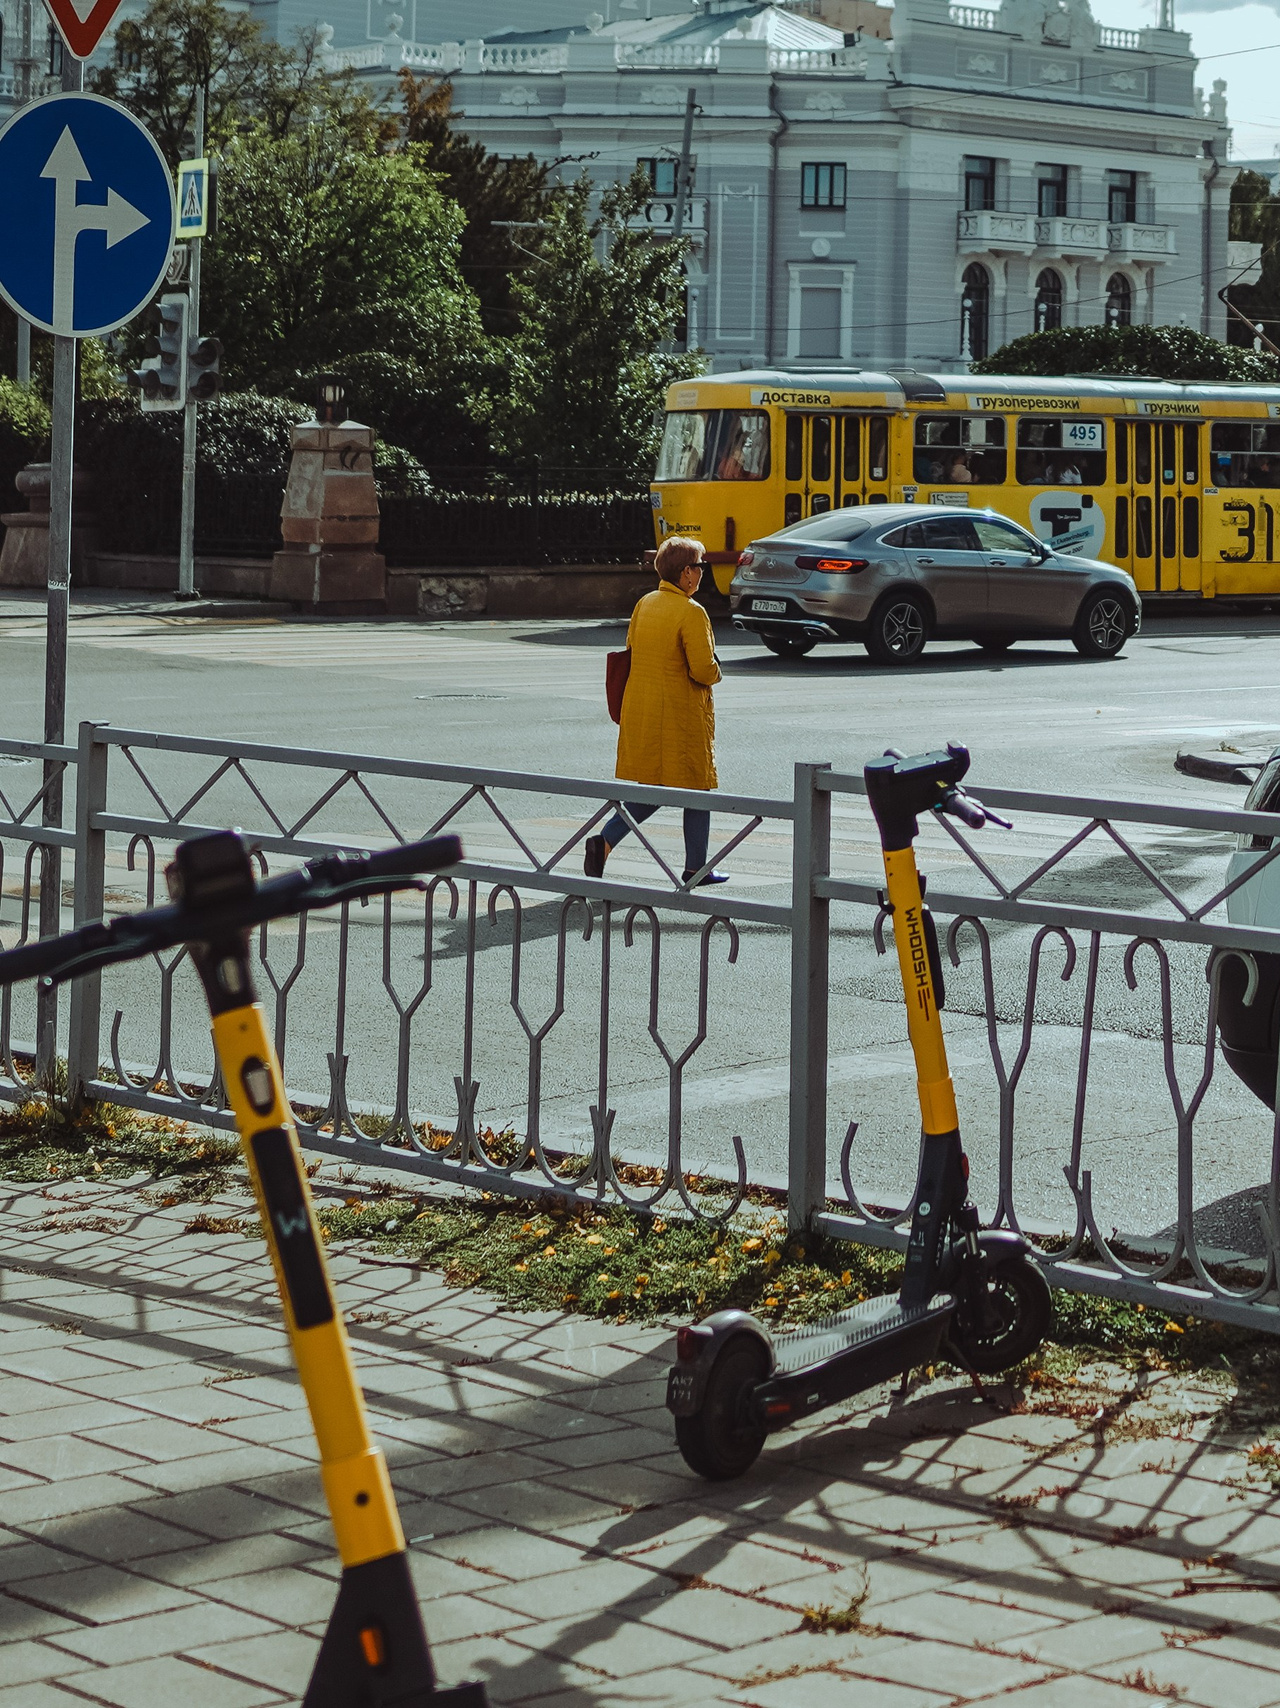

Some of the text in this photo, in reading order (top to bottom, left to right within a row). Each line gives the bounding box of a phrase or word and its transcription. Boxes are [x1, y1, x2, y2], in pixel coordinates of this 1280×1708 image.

[760, 391, 831, 405] доставка
[976, 396, 1080, 410] грузоперевозки
[1144, 402, 1200, 415] грузчики
[1069, 425, 1097, 441] 495
[904, 906, 929, 988] WHOOSH
